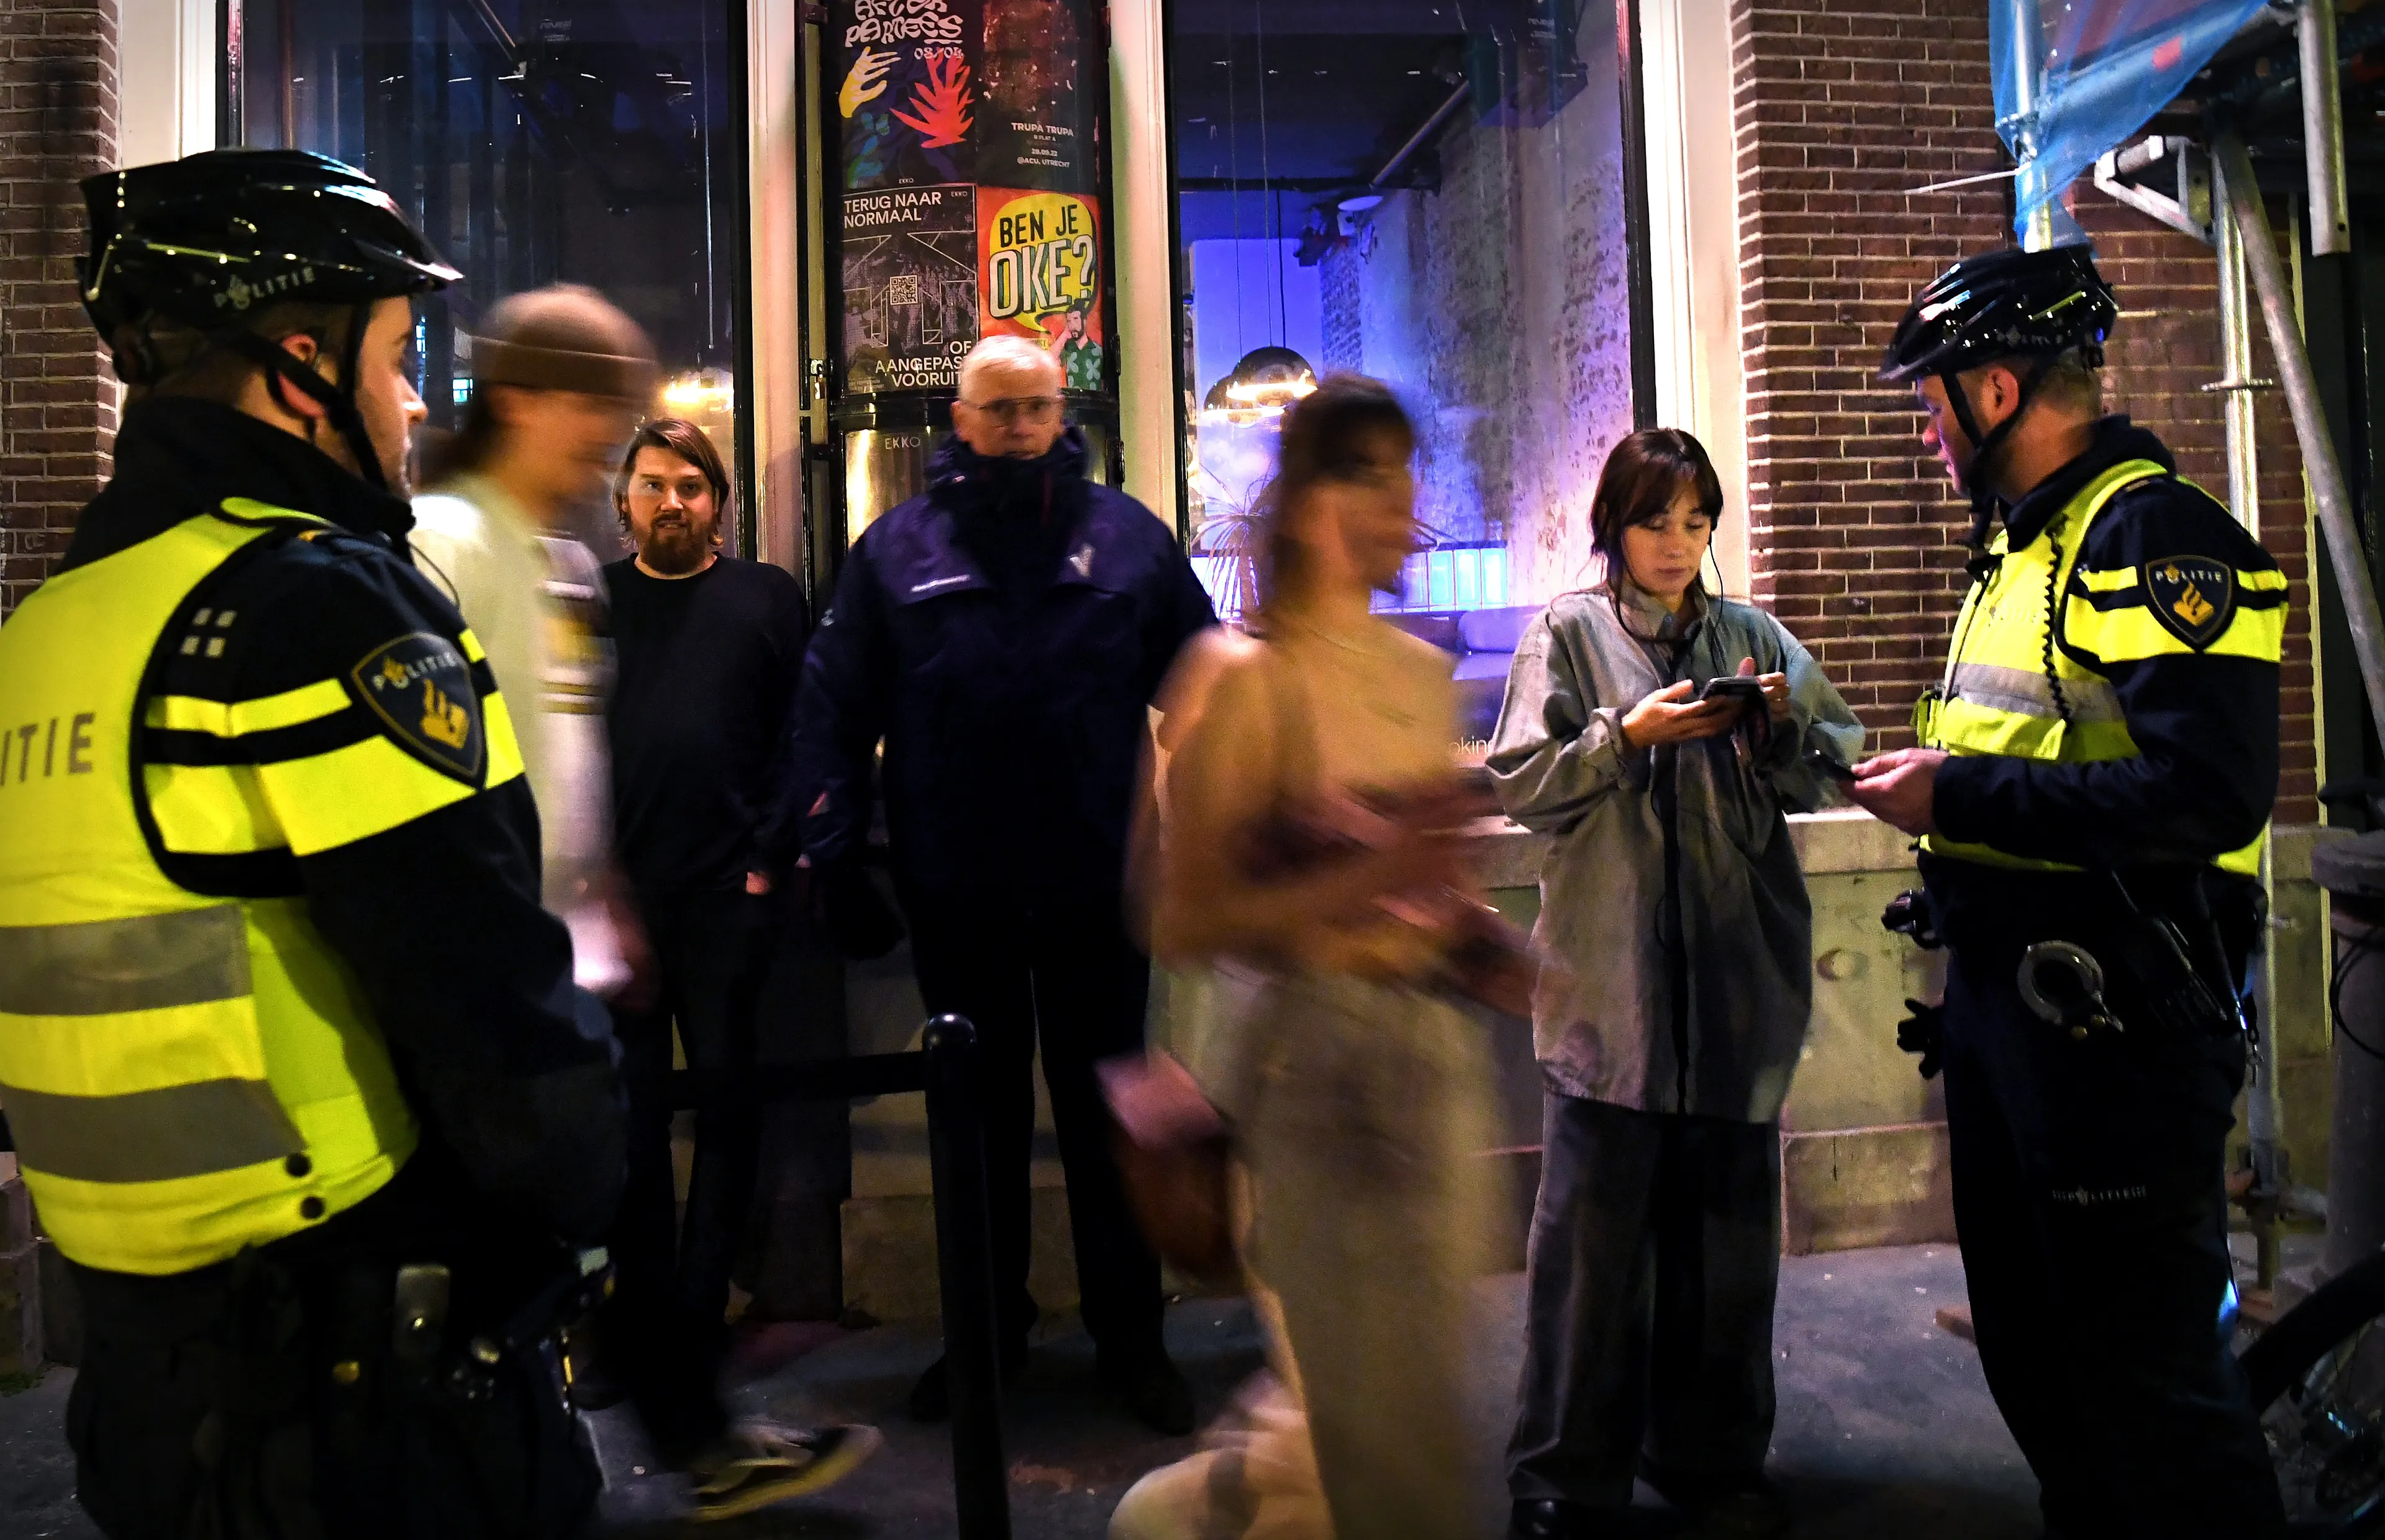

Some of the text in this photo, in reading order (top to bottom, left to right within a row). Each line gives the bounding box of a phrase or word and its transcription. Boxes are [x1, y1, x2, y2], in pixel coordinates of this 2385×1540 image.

[1011, 122, 1074, 137] TRUPA TRUPA
[1042, 159, 1070, 168] UTRECHT
[844, 191, 942, 214] TERUG NAAR
[844, 207, 922, 229] NORMAAL
[999, 204, 1078, 248] BEN JE
[989, 233, 1096, 320] OKE?
[949, 340, 972, 355] OF
[875, 355, 966, 374] AANGEPAS
[884, 437, 920, 450] EKKO
[2155, 563, 2222, 584] POLITIE
